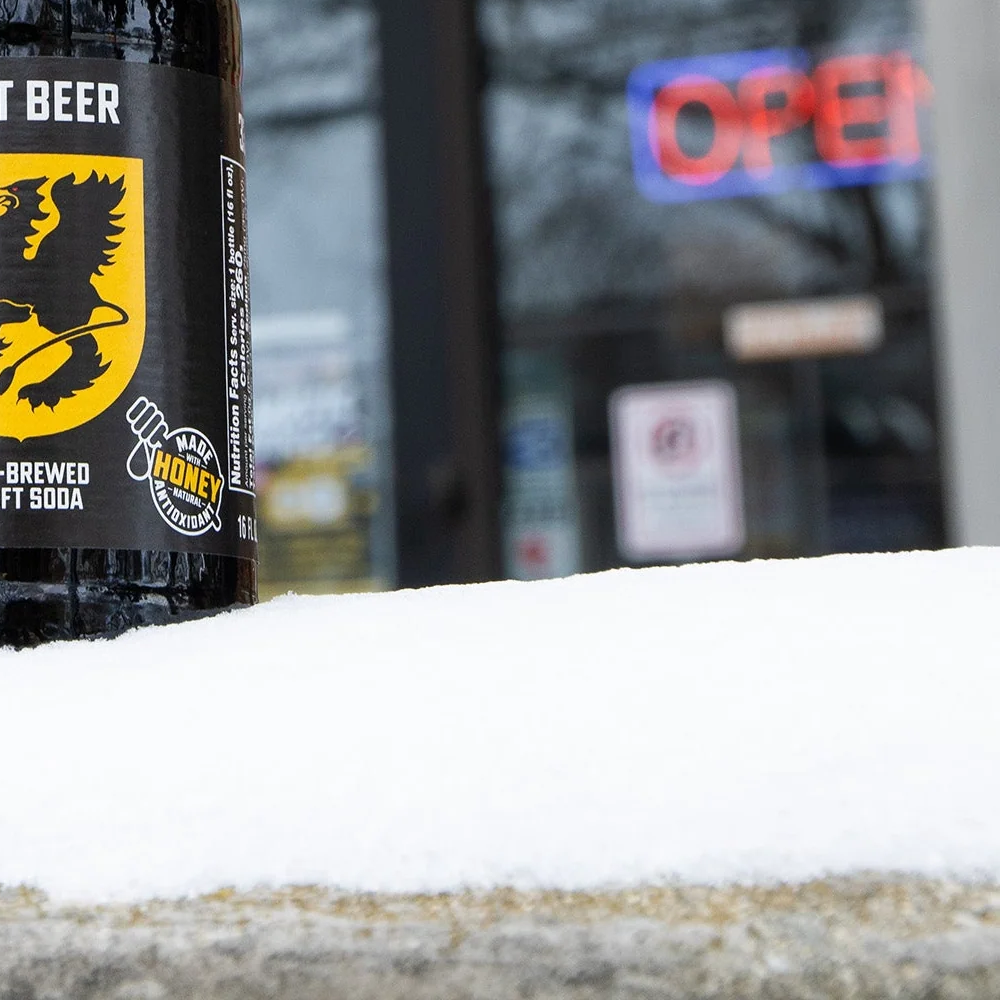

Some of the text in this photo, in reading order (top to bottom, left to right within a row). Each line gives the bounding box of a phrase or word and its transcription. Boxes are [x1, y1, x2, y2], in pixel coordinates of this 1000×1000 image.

[26, 80, 120, 124] BEER
[230, 313, 238, 346] Serv.
[238, 307, 247, 388] Calories
[229, 349, 240, 400] Facts
[176, 434, 213, 465] MADE
[186, 453, 201, 465] WITH
[230, 405, 241, 486] Nutrition
[153, 450, 221, 503] HONEY
[29, 487, 84, 510] SODA
[154, 480, 215, 529] ANTIOXIDANT
[173, 487, 202, 508] NATURAL
[238, 514, 246, 540] 16
